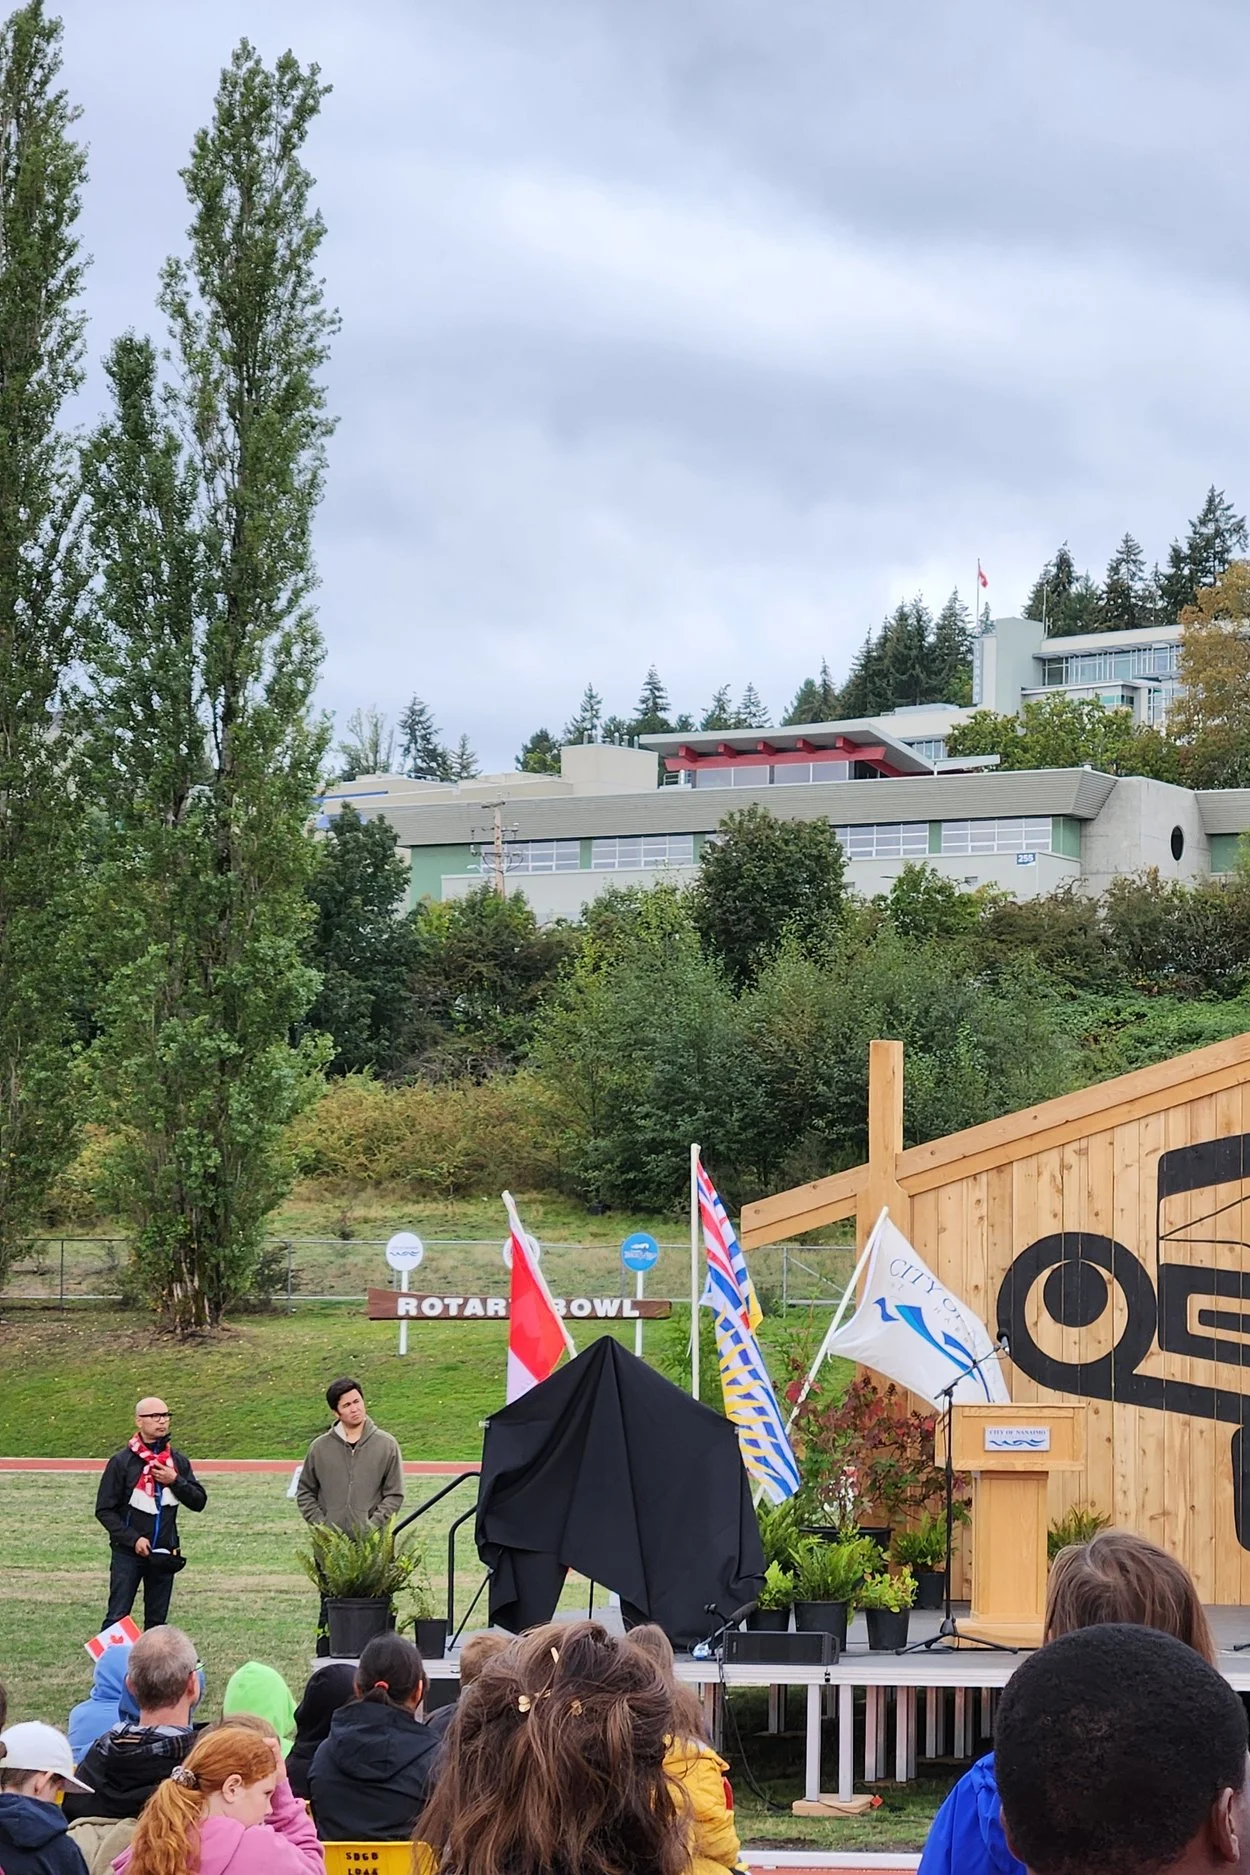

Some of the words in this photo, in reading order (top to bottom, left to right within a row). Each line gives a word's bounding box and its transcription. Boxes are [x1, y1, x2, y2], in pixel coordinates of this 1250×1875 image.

[1018, 854, 1034, 862] 255
[889, 1259, 942, 1293] CITY
[397, 1296, 511, 1317] ROTAR
